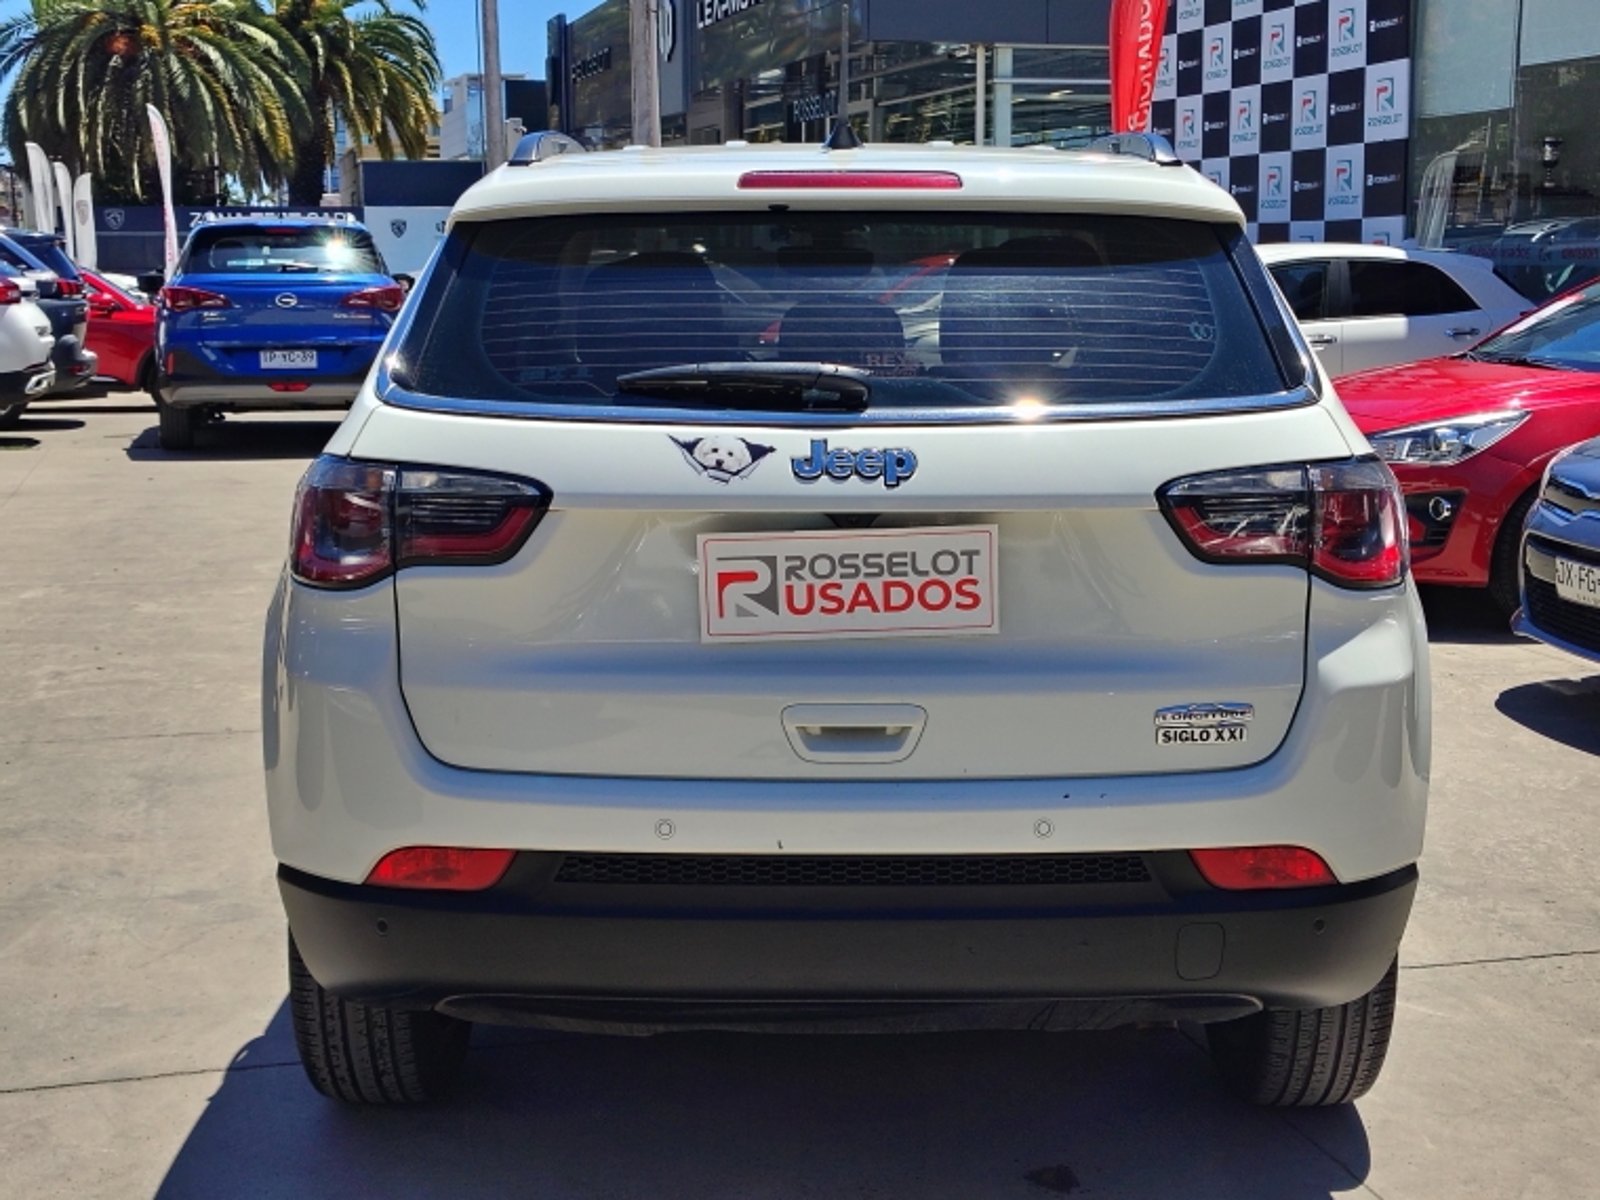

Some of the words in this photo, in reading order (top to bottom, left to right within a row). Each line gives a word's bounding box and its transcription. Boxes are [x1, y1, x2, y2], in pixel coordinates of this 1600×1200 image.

[791, 438, 918, 488] Jeep
[785, 549, 981, 581] ROSSELOT
[785, 578, 982, 616] USADOS
[1162, 730, 1211, 743] SIGLO
[1215, 727, 1243, 742] XXI
